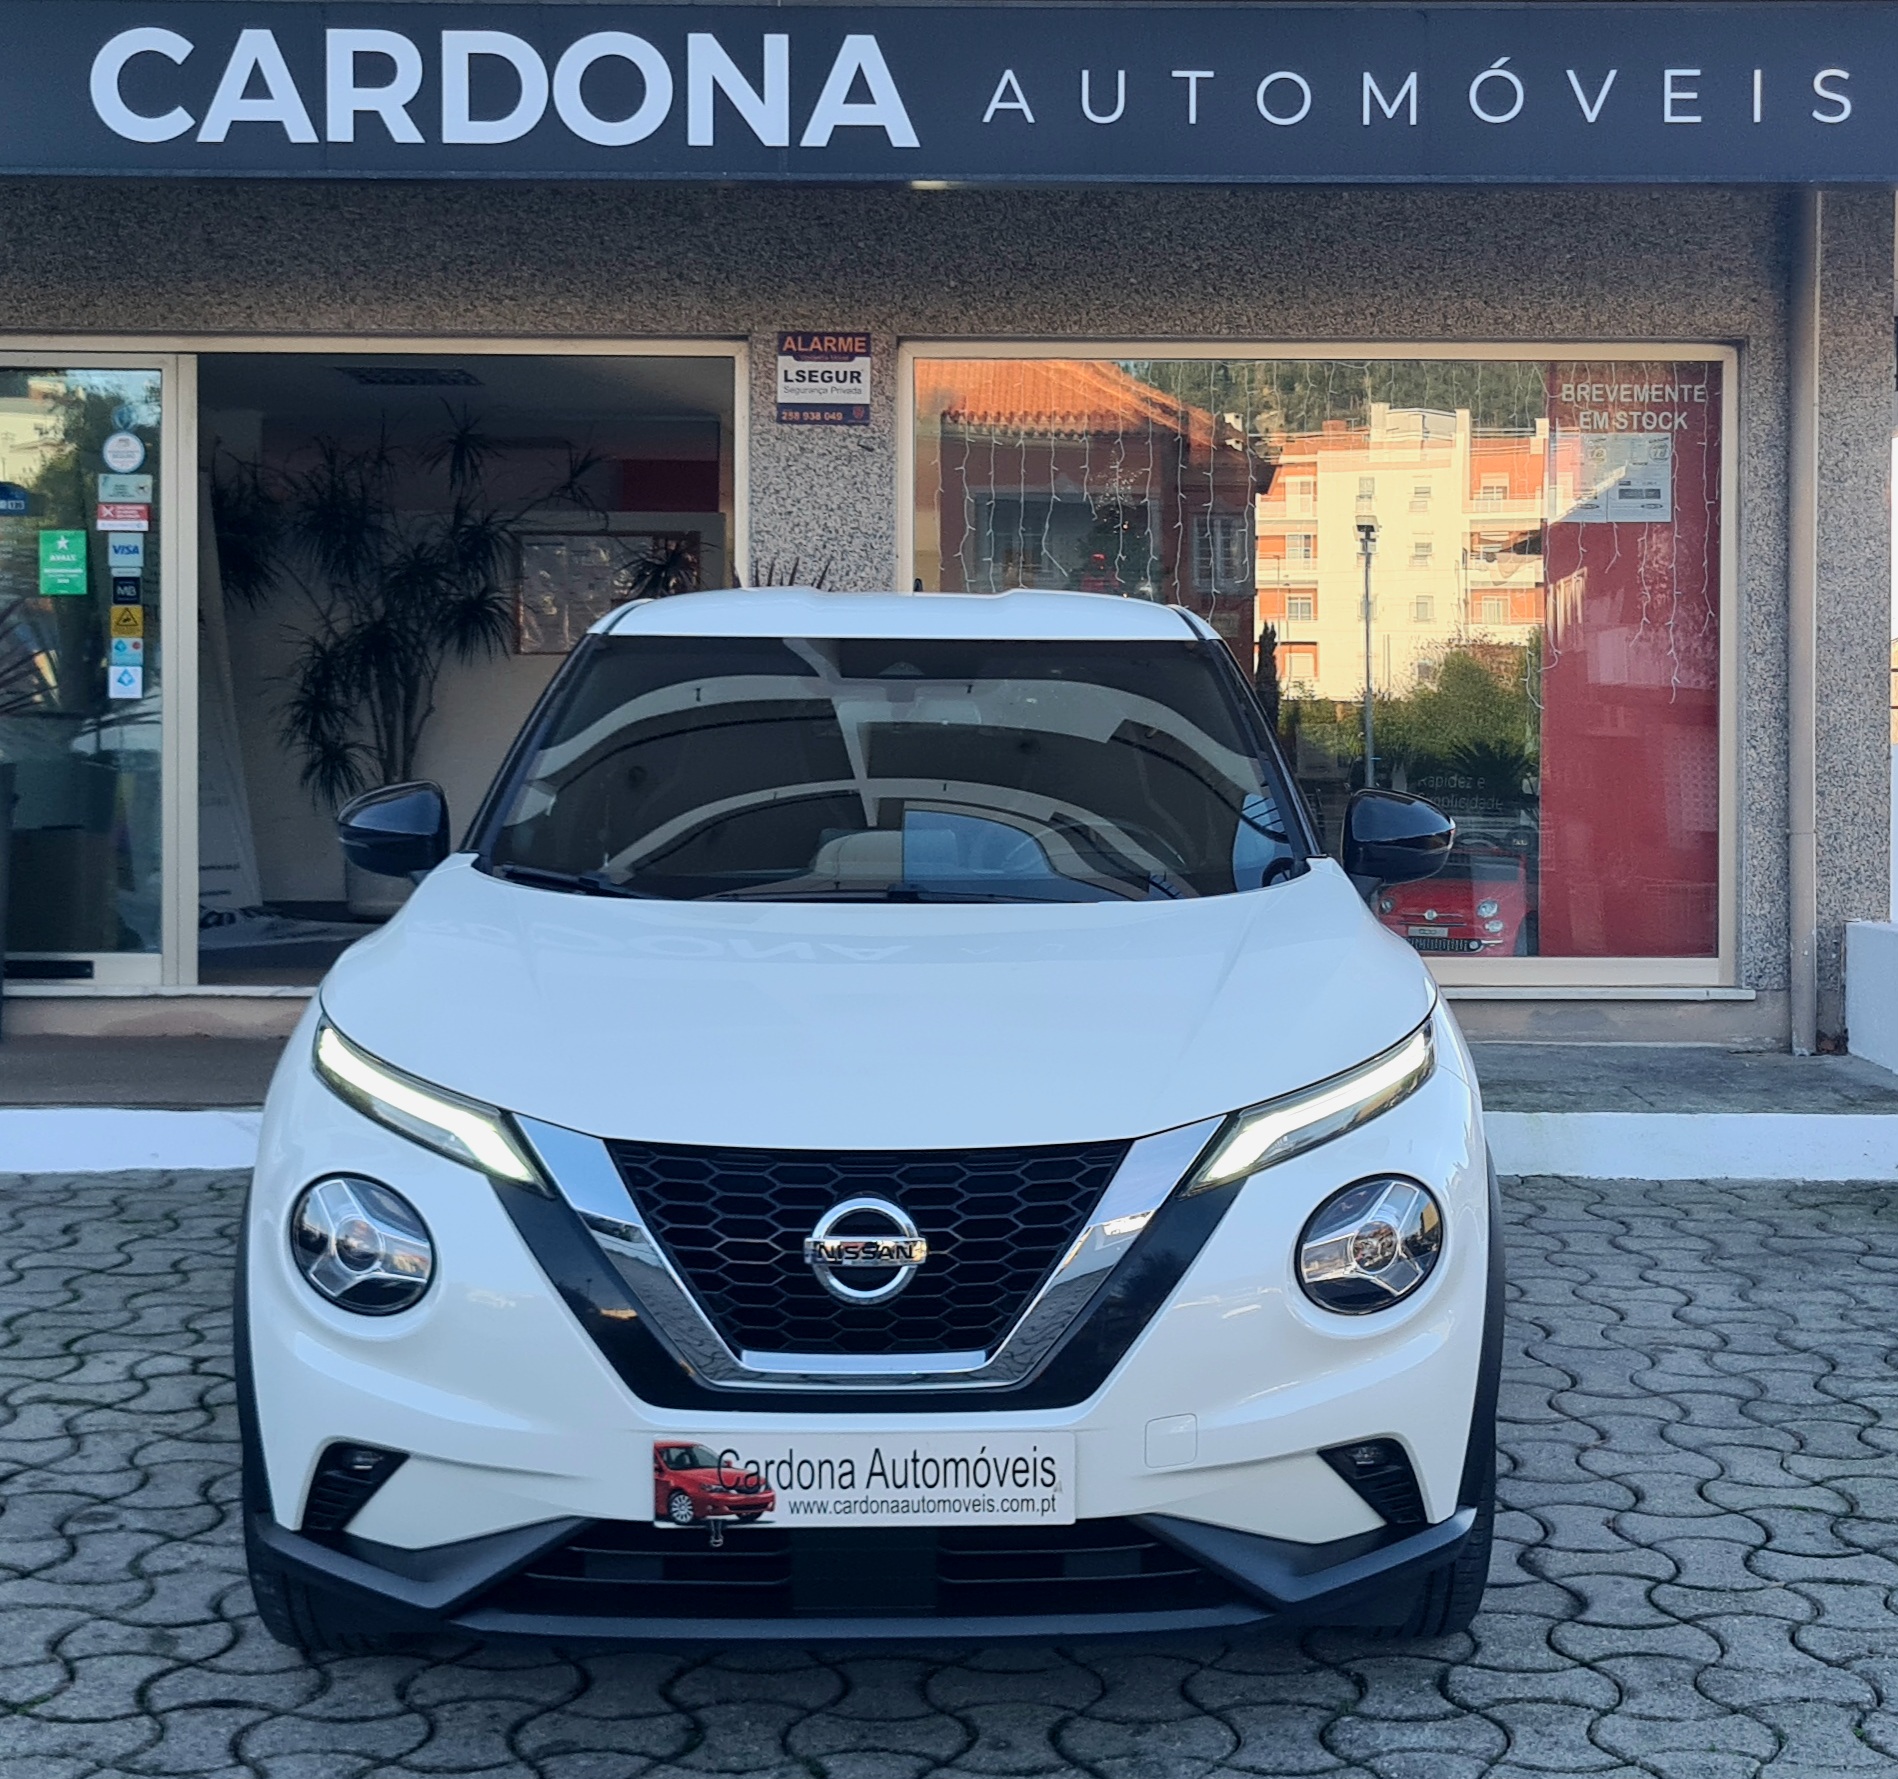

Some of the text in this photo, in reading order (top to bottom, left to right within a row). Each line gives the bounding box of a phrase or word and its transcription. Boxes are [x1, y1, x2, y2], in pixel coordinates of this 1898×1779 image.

[89, 26, 1854, 149] CARDONA AUTOMÓVEIS
[782, 335, 867, 353] ALARME
[783, 369, 862, 384] LSEGUR
[783, 385, 862, 397] Segurança Privada
[1561, 383, 1707, 403] BREVEMENTE
[1579, 411, 1688, 430] EM STOCK
[112, 544, 140, 555] VISA
[1477, 777, 1486, 789] e
[816, 1243, 914, 1261] NISSAN
[717, 1445, 1057, 1490] Cardona Automóveis
[788, 1493, 1057, 1518] www.cardonaautomoveis.com.pt
